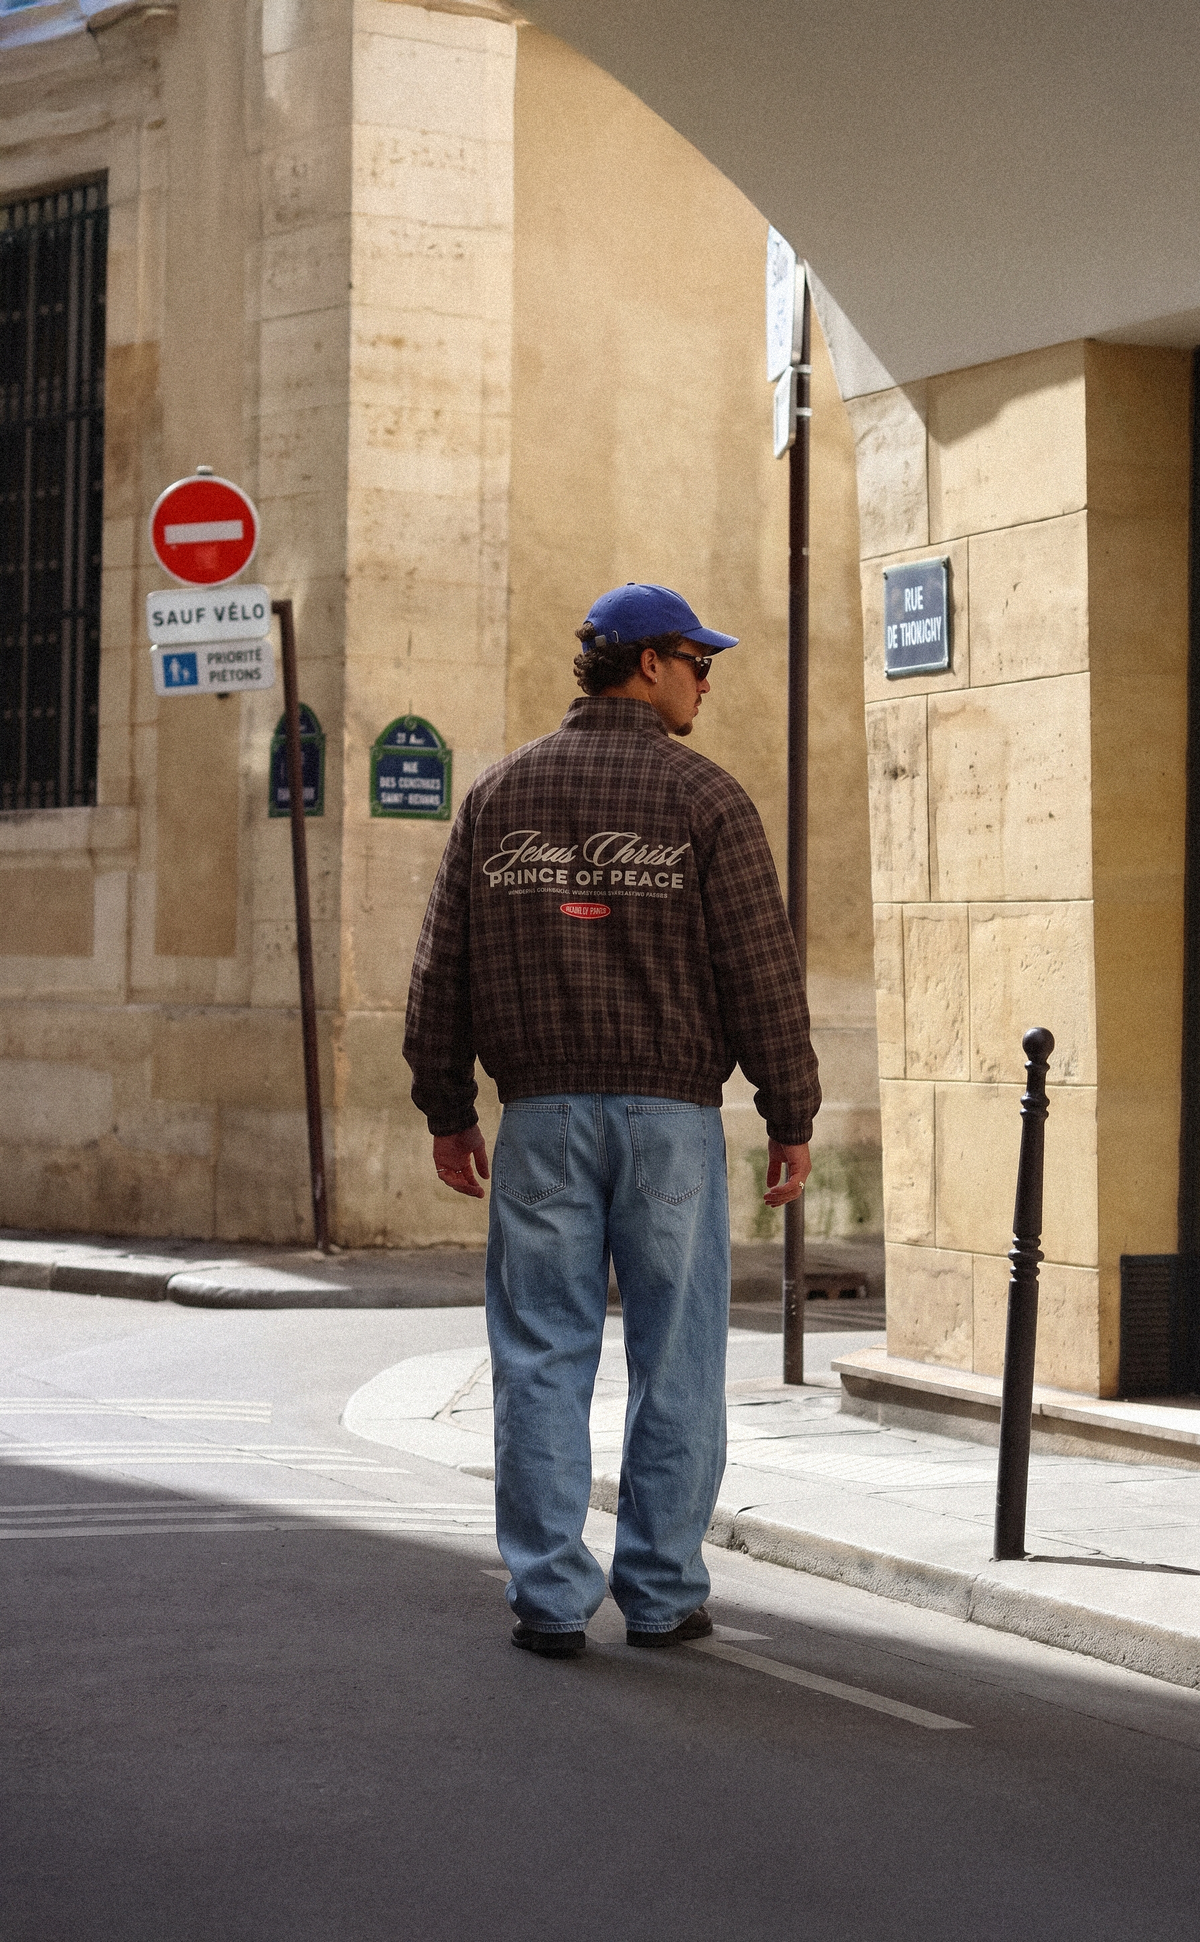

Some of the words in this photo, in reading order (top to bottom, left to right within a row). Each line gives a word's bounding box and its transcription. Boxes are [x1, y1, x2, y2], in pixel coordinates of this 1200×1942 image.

[904, 585, 924, 613] RUE
[152, 607, 206, 627] SAUF
[213, 601, 265, 622] VÉLO
[887, 624, 899, 650] DE
[207, 648, 262, 664] PRIORITÉ
[209, 667, 262, 683] PIÉTONS
[482, 829, 579, 876] Jesus
[582, 830, 691, 867] Christ
[489, 868, 568, 888] PRINCE
[575, 870, 604, 886] OF
[610, 870, 684, 889] PEACE
